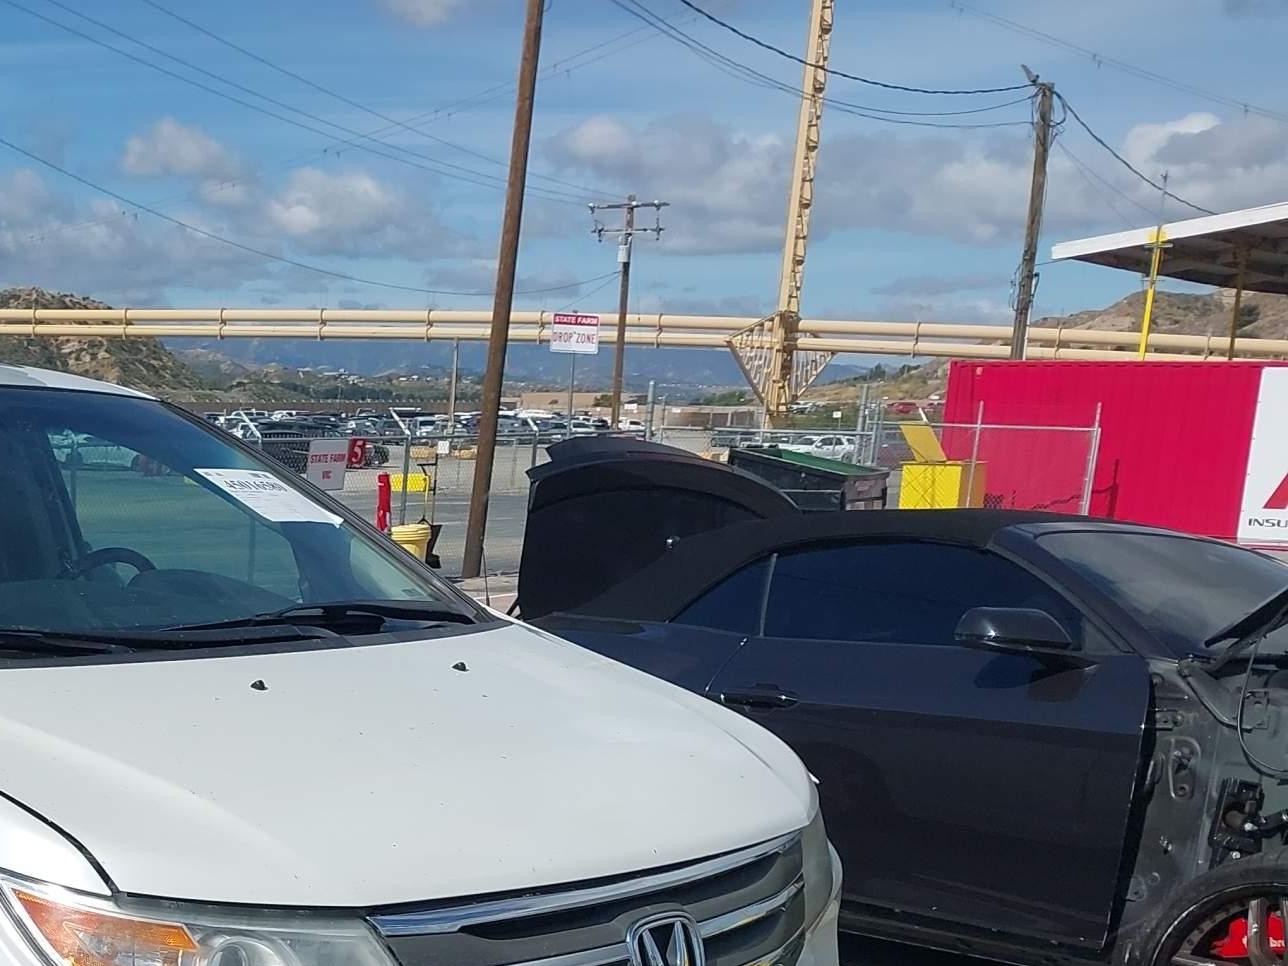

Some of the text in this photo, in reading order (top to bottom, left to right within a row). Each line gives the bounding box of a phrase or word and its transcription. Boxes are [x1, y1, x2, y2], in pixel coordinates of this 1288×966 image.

[555, 316, 598, 325] STATE FARM
[553, 332, 596, 345] DROP ZONE
[352, 440, 364, 462] 5
[310, 454, 329, 464] STATE
